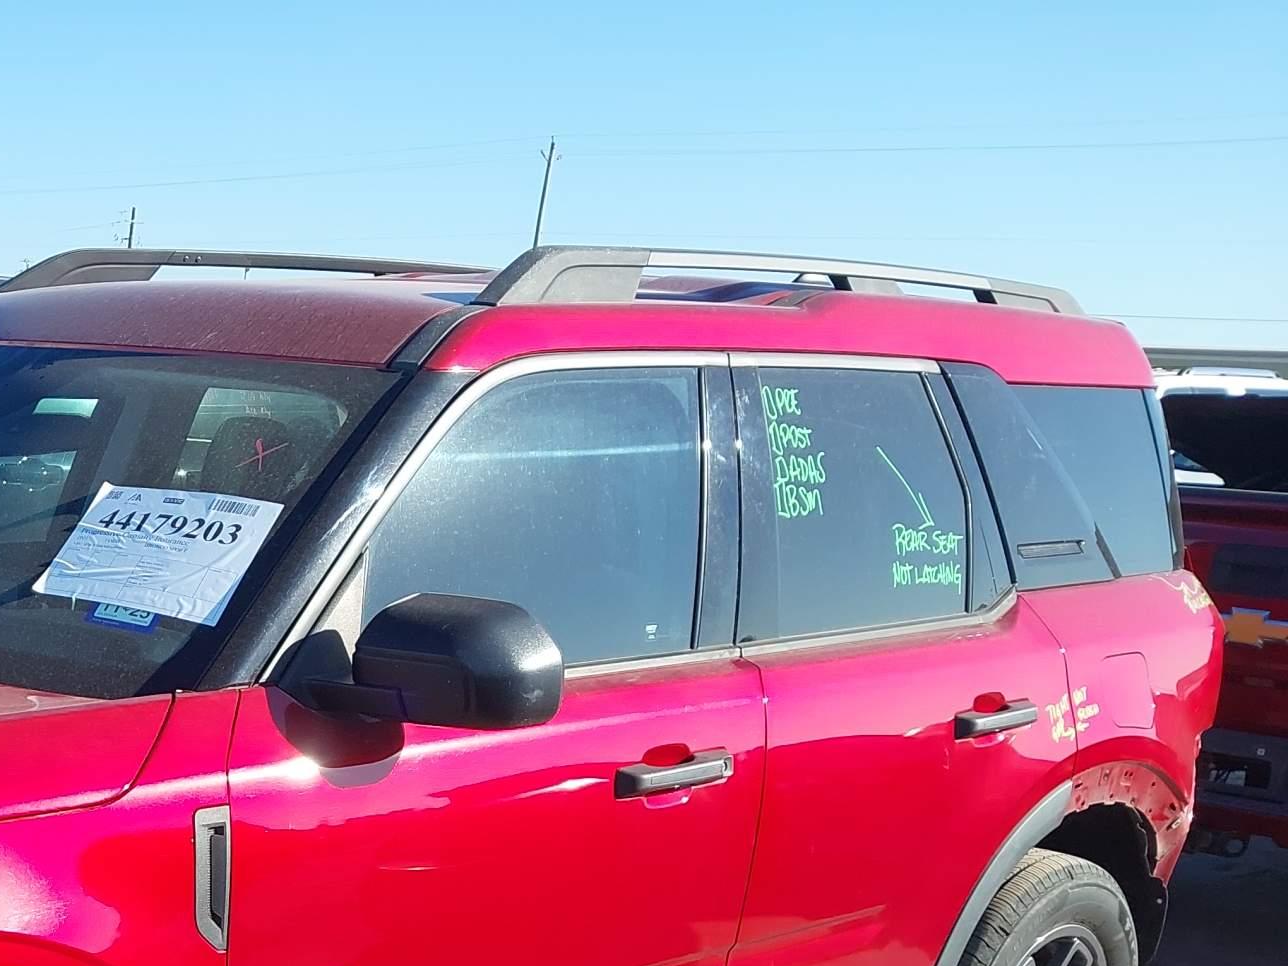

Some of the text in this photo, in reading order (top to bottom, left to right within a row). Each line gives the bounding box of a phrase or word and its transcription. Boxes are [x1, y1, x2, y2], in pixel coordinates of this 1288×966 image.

[98, 508, 242, 546] 44179203
[892, 523, 963, 557] REAR SEAT
[892, 561, 962, 595] NOT LATCHING
